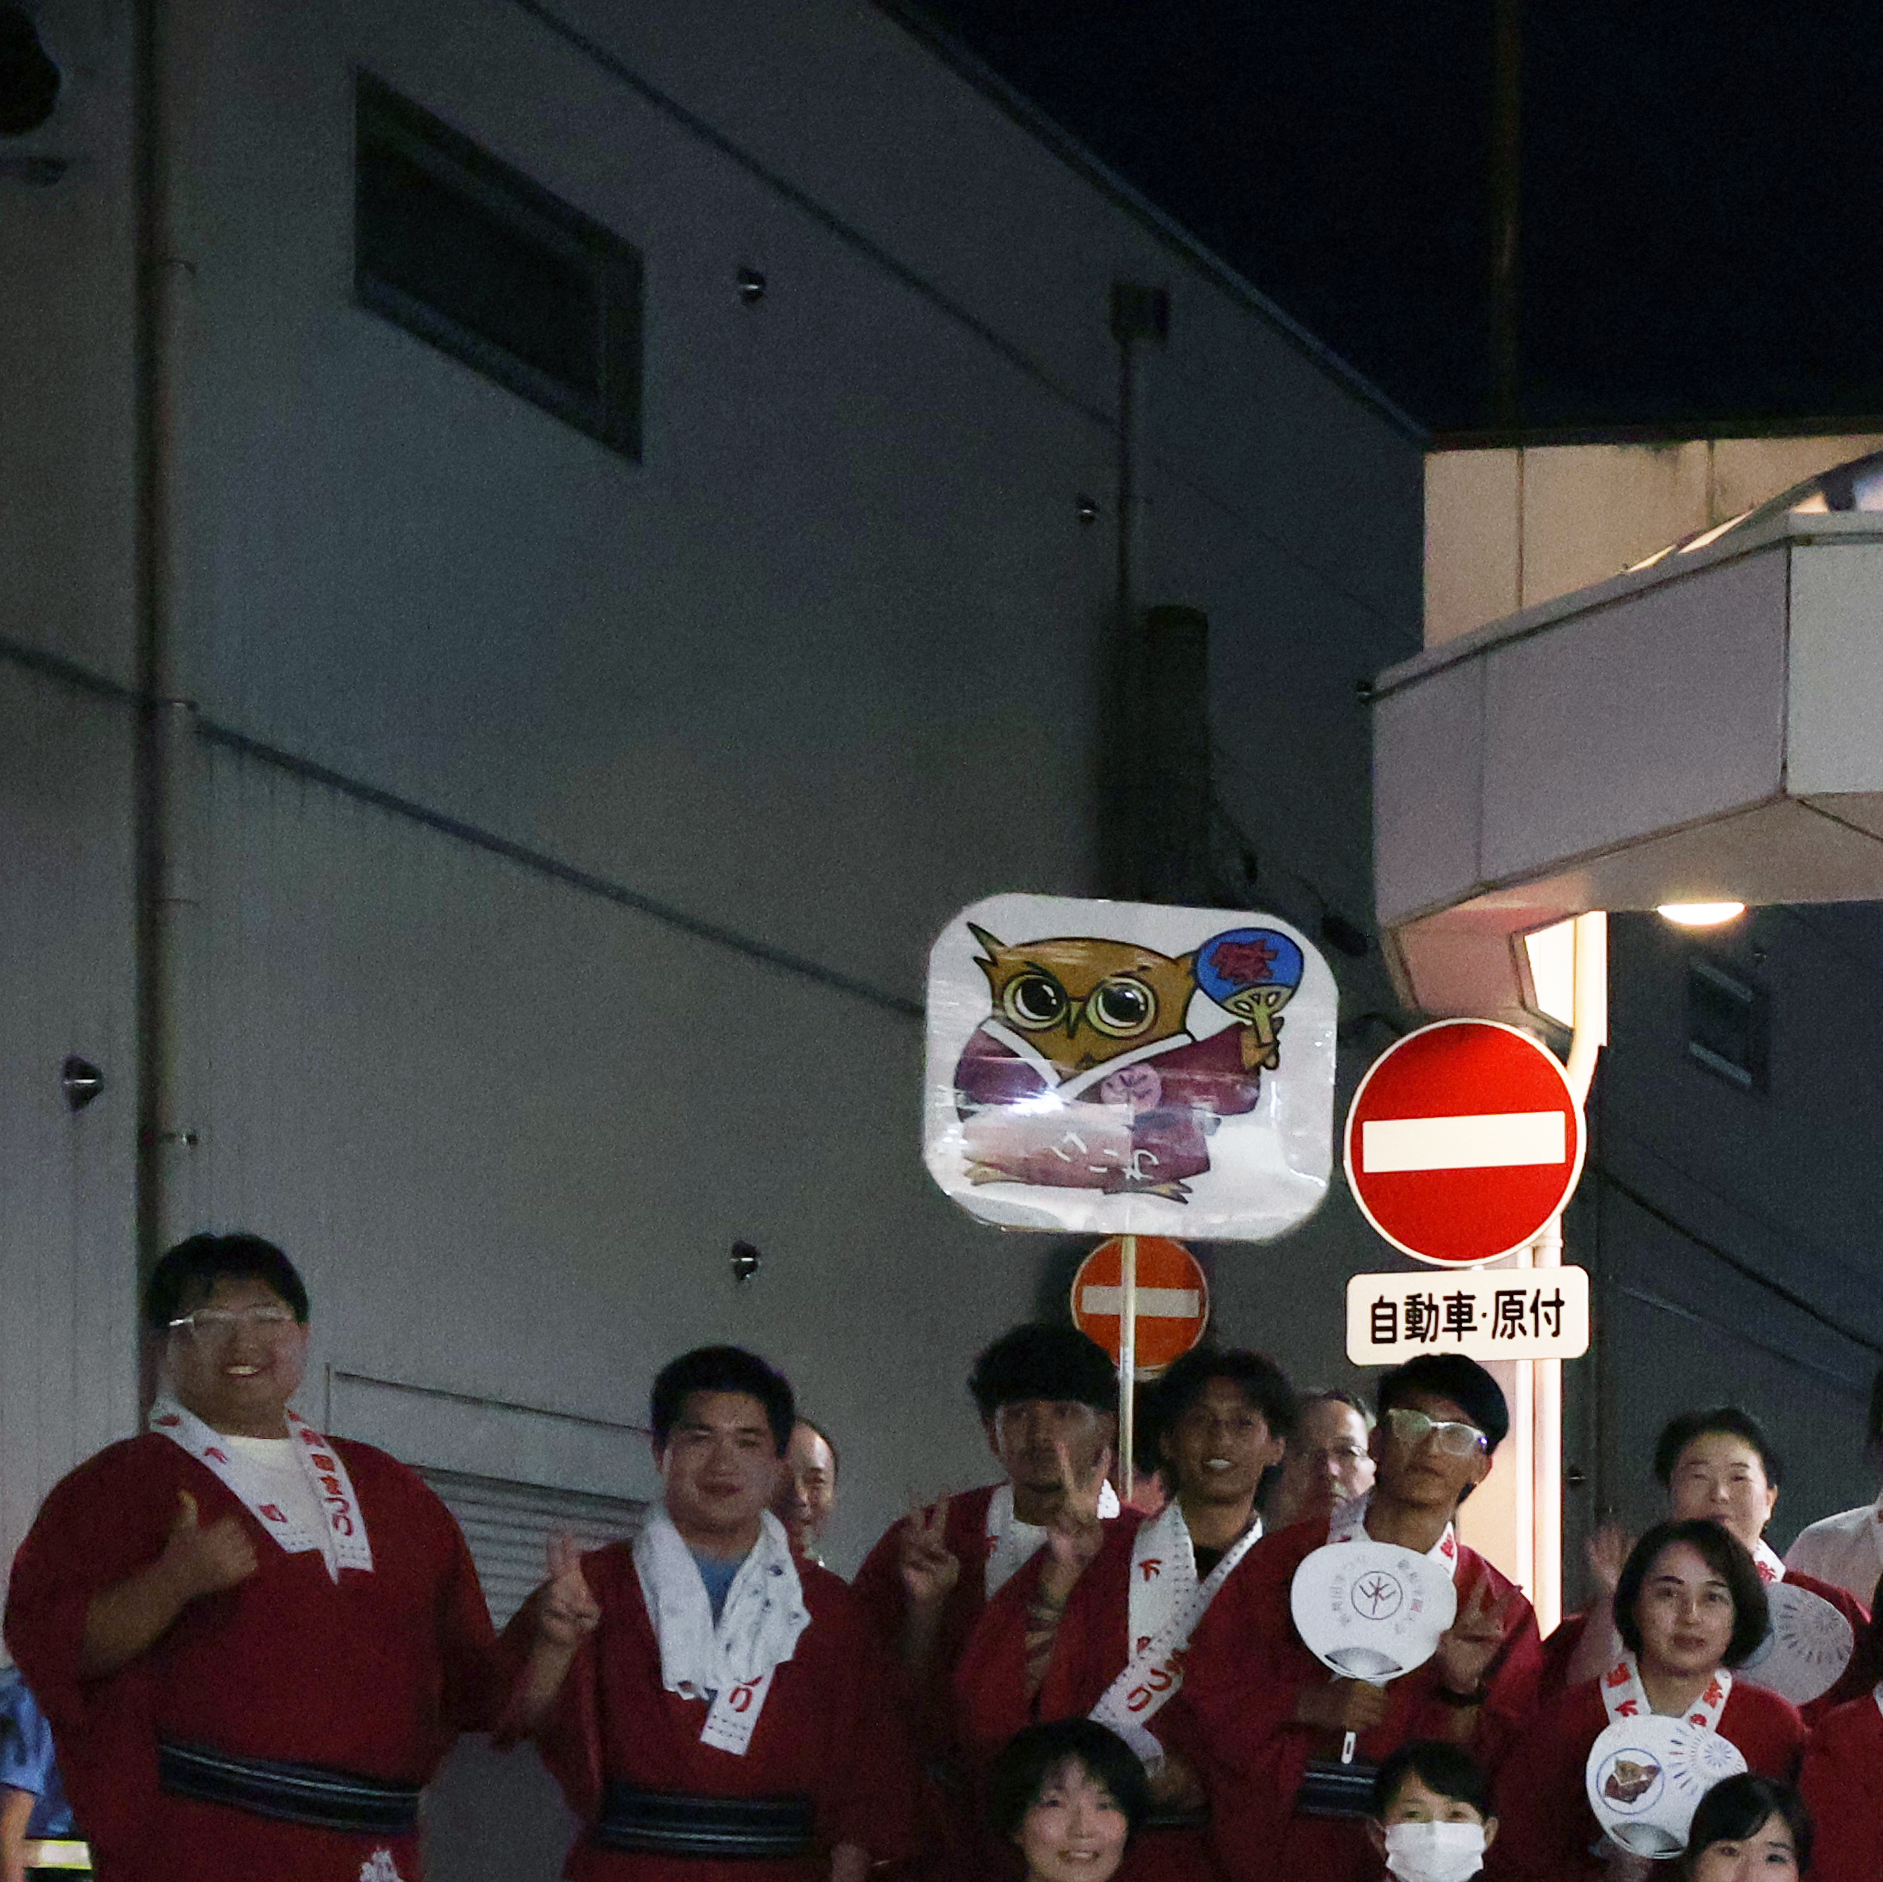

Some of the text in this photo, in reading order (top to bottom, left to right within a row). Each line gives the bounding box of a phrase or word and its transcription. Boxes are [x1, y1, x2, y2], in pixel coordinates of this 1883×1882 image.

[1371, 1287, 1565, 1344] 自動車・原付
